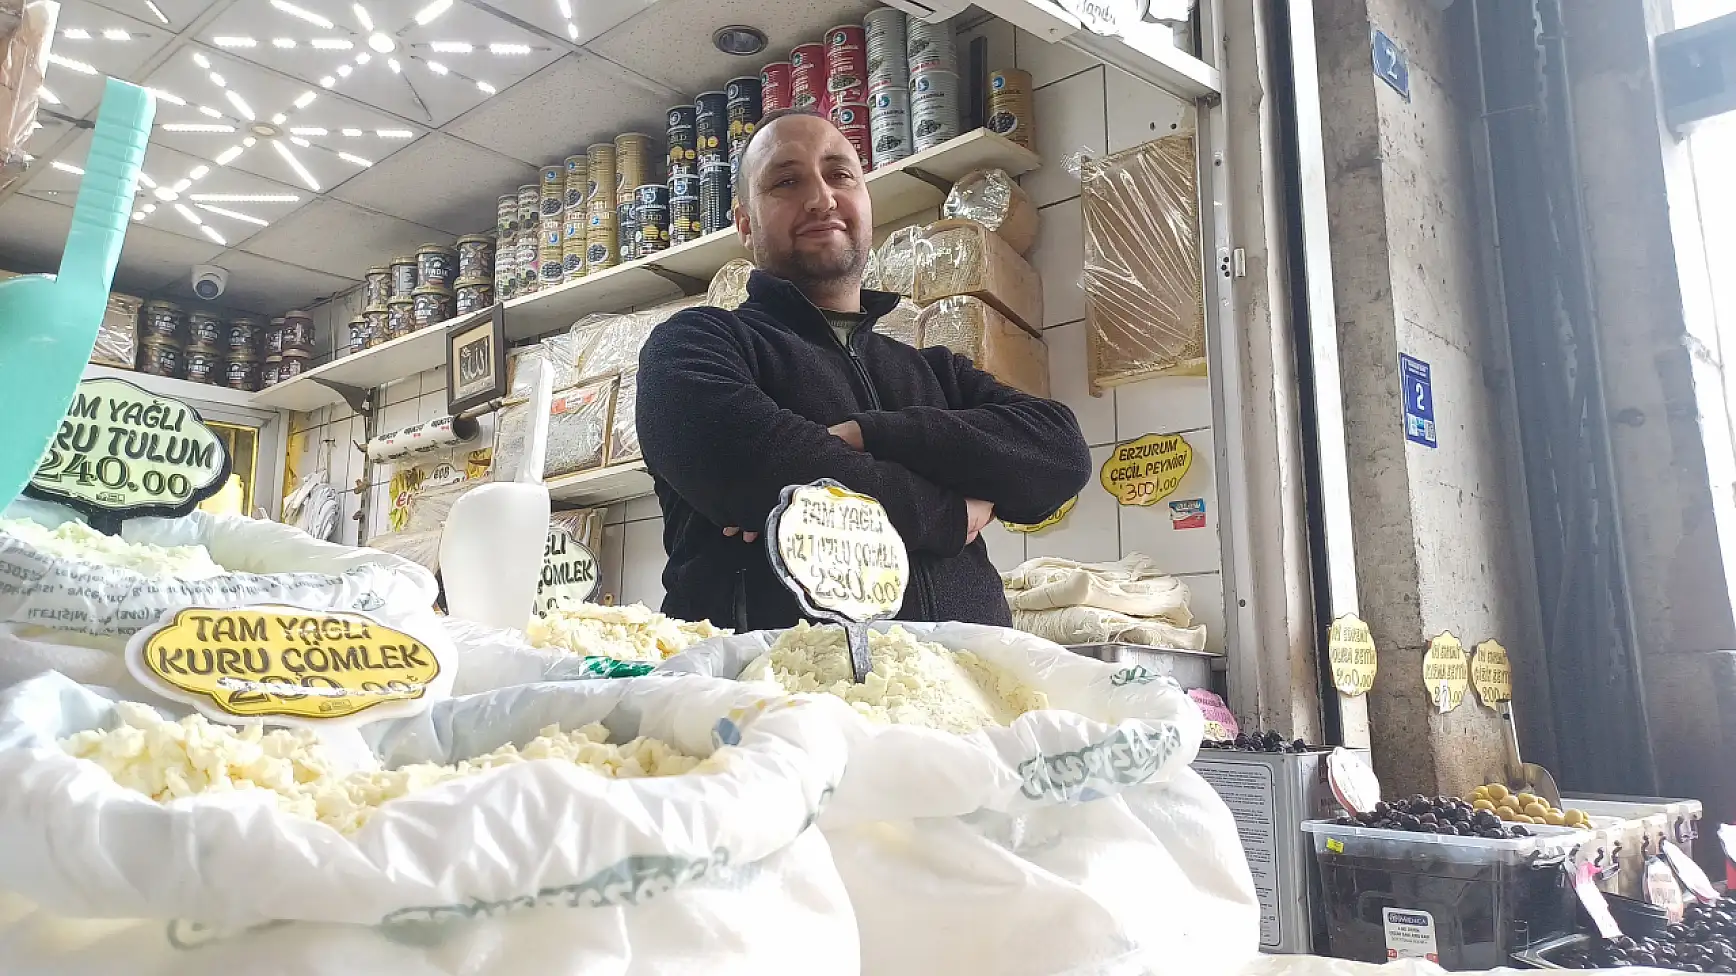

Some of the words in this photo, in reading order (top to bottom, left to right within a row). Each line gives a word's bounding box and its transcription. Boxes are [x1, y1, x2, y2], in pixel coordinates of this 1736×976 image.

[1385, 47, 1398, 80] 2
[1415, 382, 1425, 411] 2
[109, 400, 186, 432] YAĞLI
[108, 427, 215, 469] TULUM
[1119, 438, 1178, 462] ERZURUM
[801, 498, 834, 528] TAM
[190, 616, 269, 642] TAM
[158, 646, 270, 676] KURU
[281, 640, 428, 678] ÇÖMLEK
